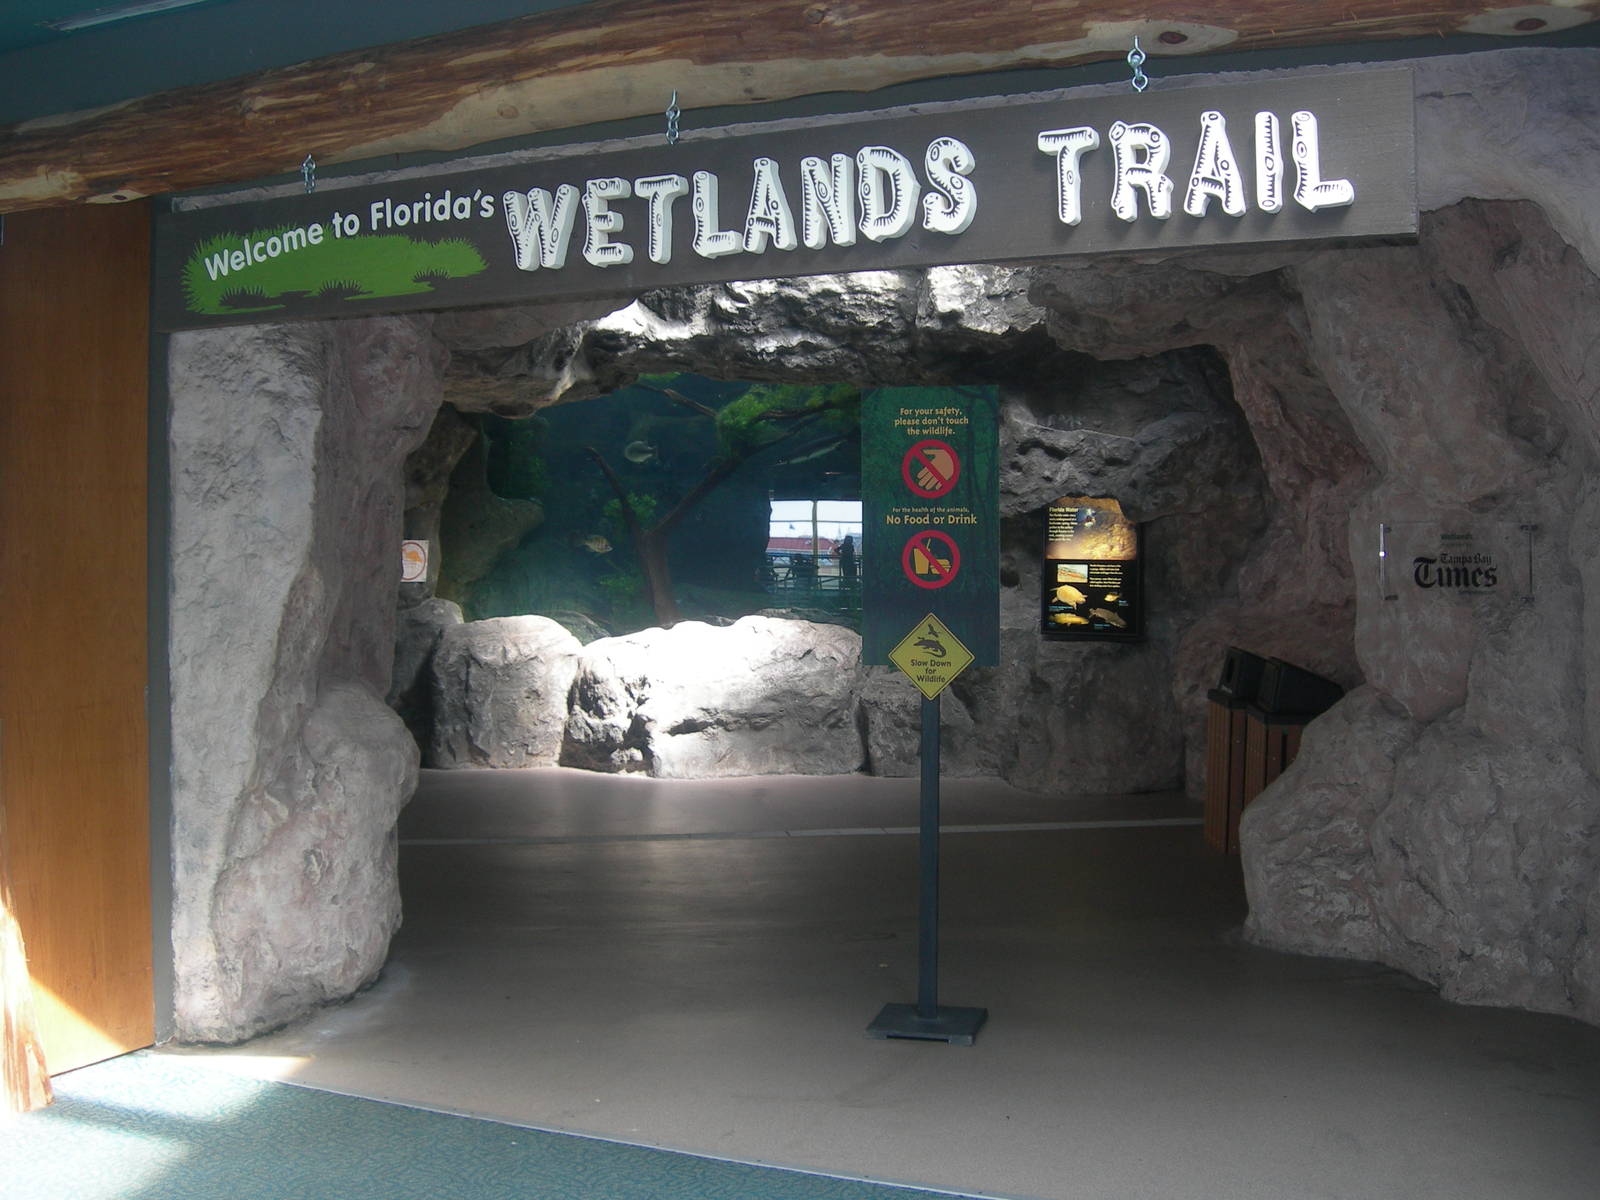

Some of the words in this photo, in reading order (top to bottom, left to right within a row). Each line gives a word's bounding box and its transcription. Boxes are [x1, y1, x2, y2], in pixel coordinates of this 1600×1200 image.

[205, 223, 323, 281] Welcome
[332, 211, 360, 238] to
[370, 188, 495, 231] Florida's
[502, 136, 977, 272] WETLANDS
[1037, 110, 1354, 226] TRAIL
[915, 408, 933, 417] your
[895, 417, 920, 427] please
[921, 416, 944, 425] don't
[946, 416, 969, 425] touch
[907, 427, 920, 435] the
[922, 426, 956, 437] wildlife.
[886, 514, 901, 524] No
[904, 513, 930, 524] Food
[933, 516, 945, 524] or
[948, 513, 977, 524] Drink
[1440, 553, 1472, 566] Tampa
[1473, 552, 1492, 566] Bay
[1413, 556, 1498, 588] Times
[911, 659, 928, 667] Slow
[930, 659, 952, 667] Down
[917, 675, 946, 683] Wildlife
